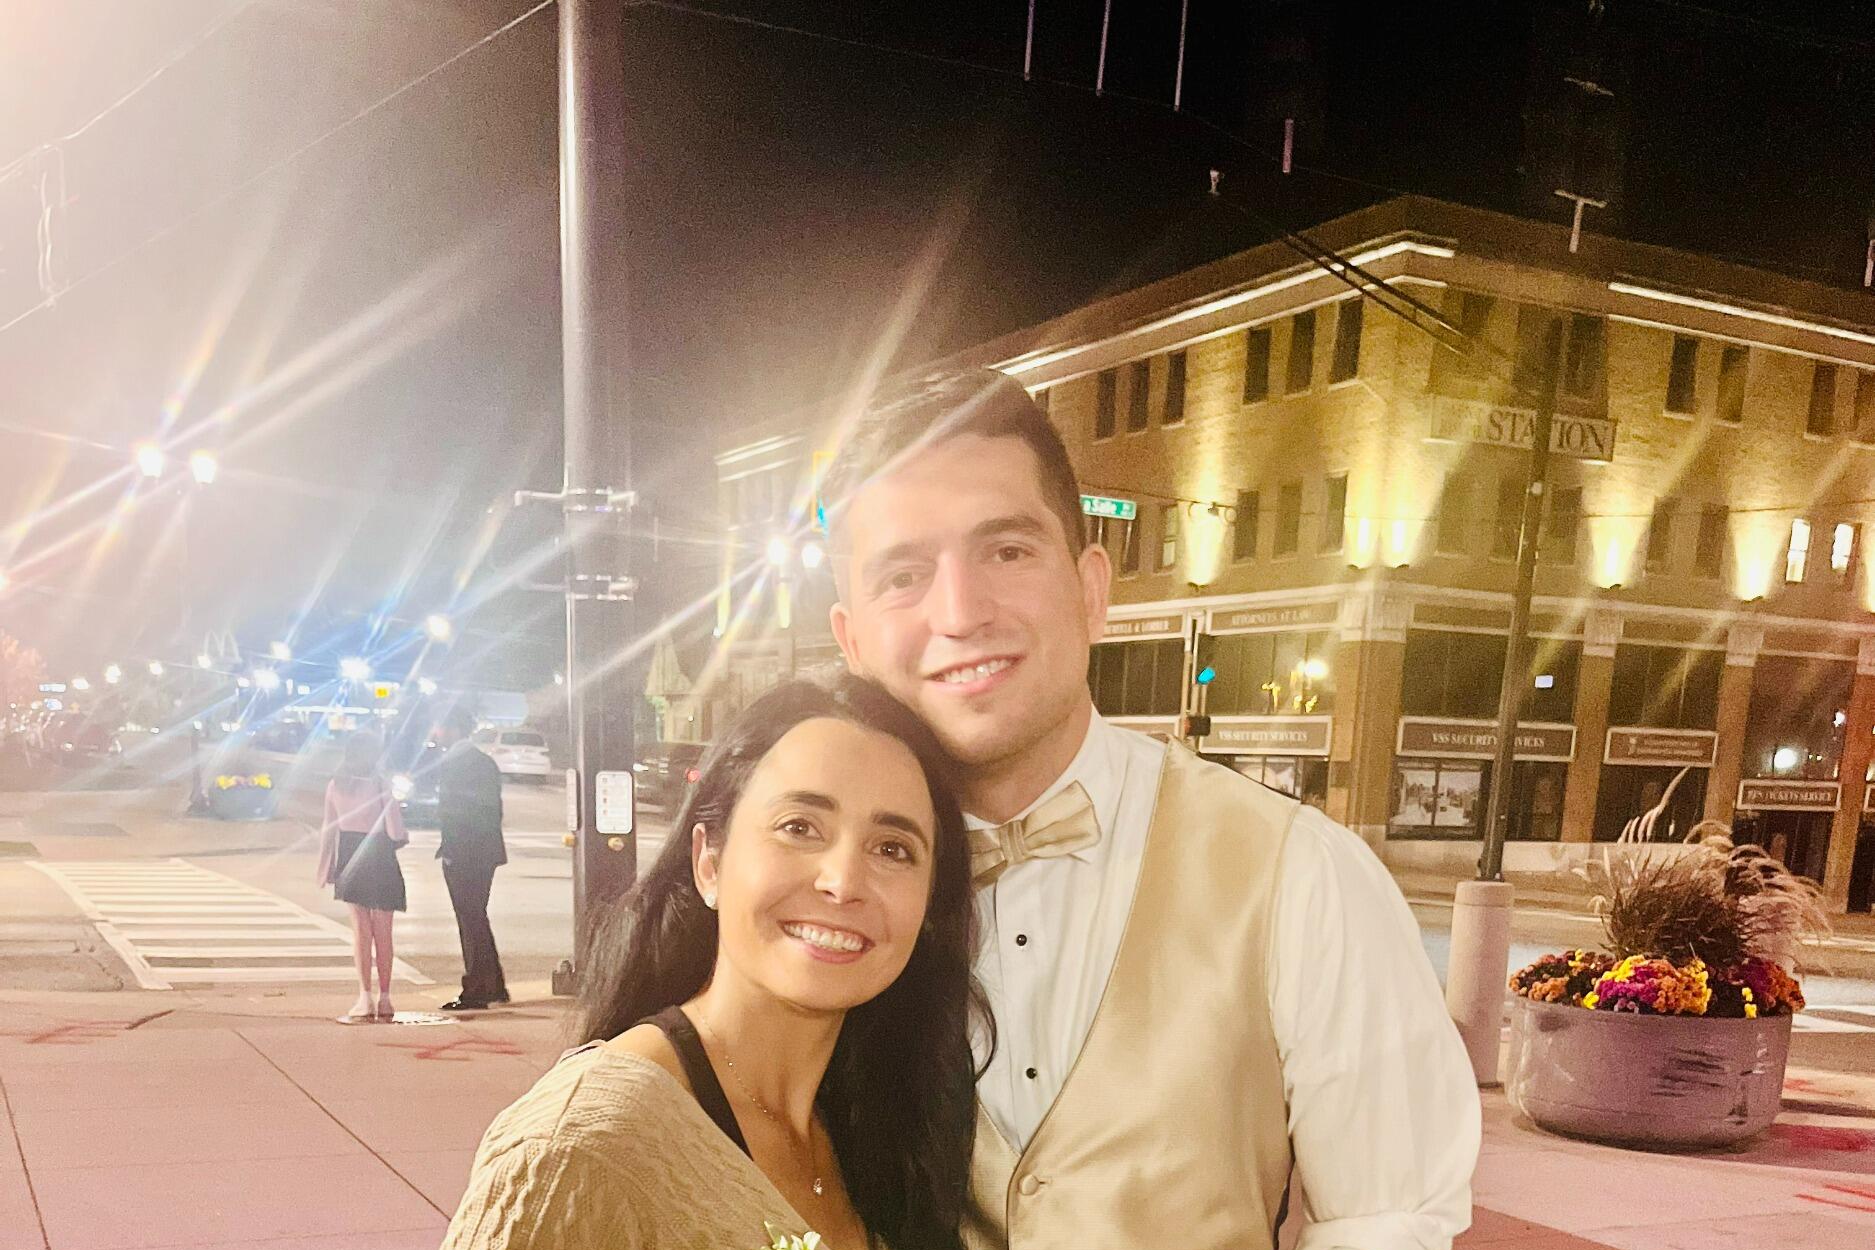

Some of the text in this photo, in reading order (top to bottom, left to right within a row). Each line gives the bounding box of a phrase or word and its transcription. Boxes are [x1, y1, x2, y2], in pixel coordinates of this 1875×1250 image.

[1487, 409, 1608, 454] STAION
[1432, 732, 1450, 744] VSS
[1451, 733, 1498, 746] SECURITY
